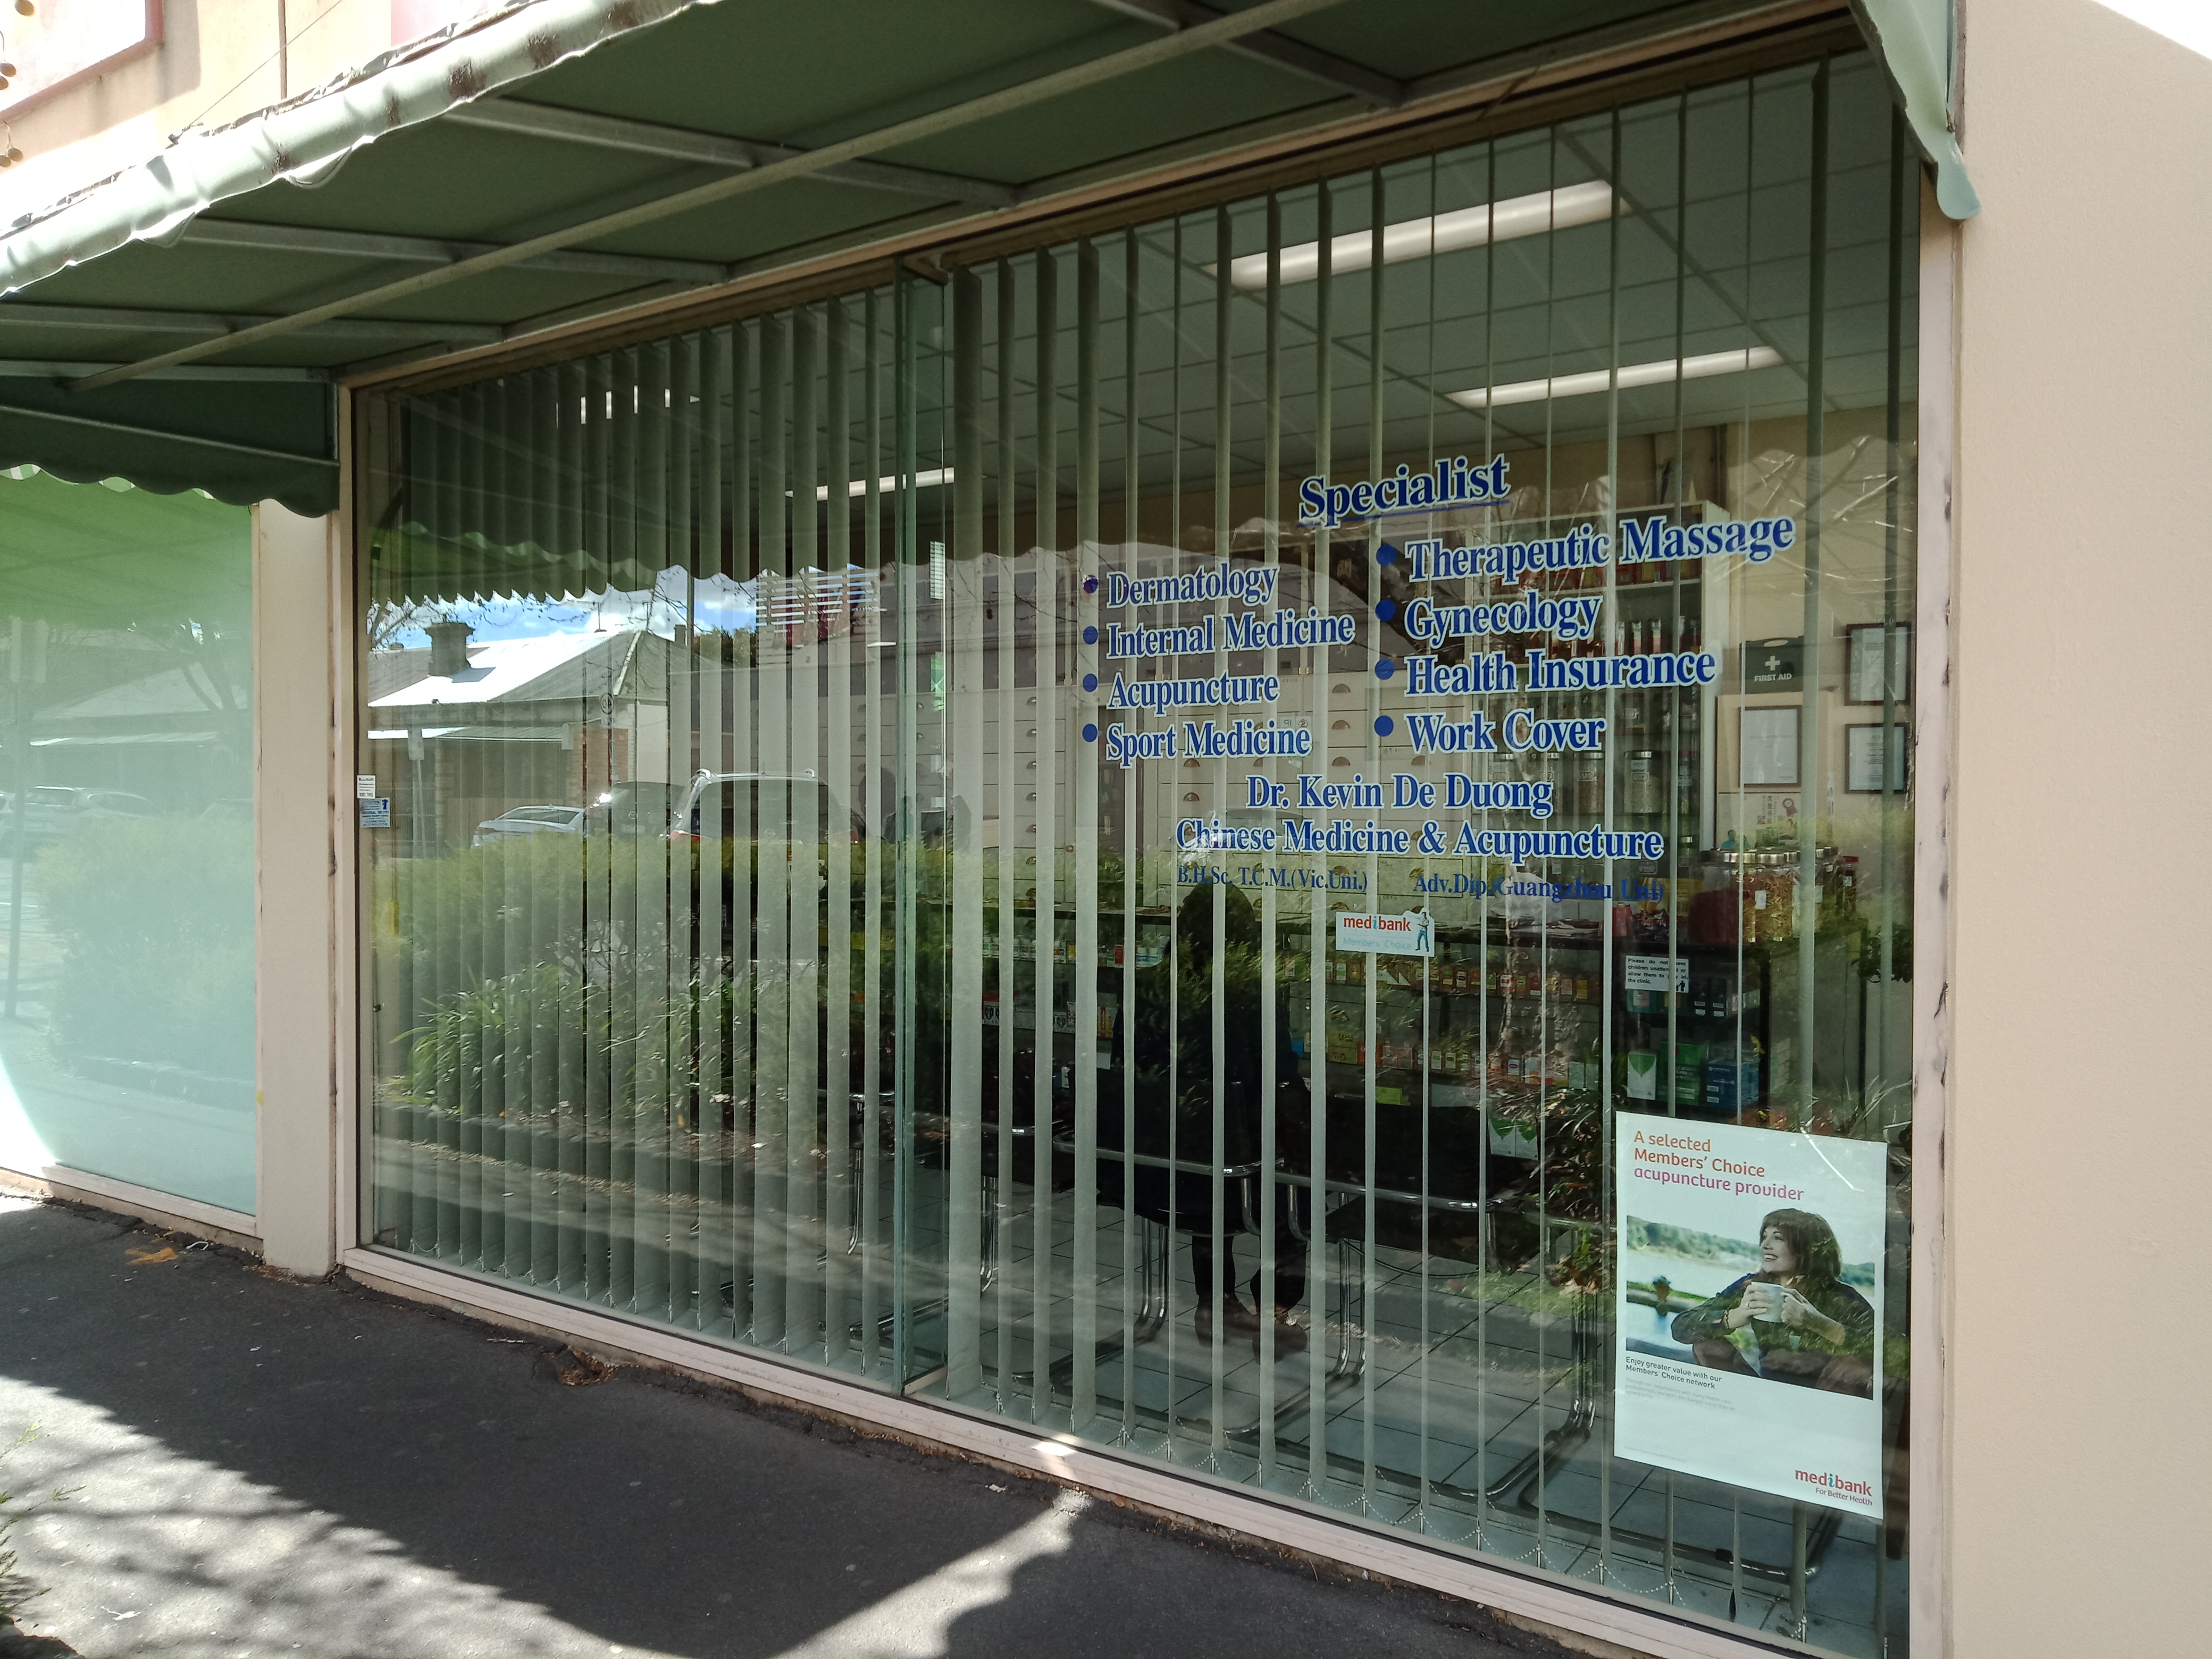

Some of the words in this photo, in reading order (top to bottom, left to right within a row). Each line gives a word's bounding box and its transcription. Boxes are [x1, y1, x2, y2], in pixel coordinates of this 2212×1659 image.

[1301, 455, 1509, 526] Specialist
[1407, 524, 1608, 583] Therapeutic
[1621, 517, 1795, 562] Massage
[1109, 565, 1278, 606] Dermatology
[1109, 616, 1213, 658] Internal
[1224, 608, 1354, 649] Medicine
[1407, 593, 1601, 646] Gynecology
[1109, 672, 1279, 714] Acupuncture
[1406, 650, 1515, 695] Health
[1528, 650, 1715, 690] Insurance
[1754, 674, 1777, 682] FIRST
[1108, 723, 1176, 766] Sport
[1185, 720, 1311, 757] Medicine
[1406, 713, 1497, 752] Work
[1505, 710, 1605, 751] Cover
[1248, 775, 1289, 808] Dr.
[1298, 774, 1382, 808] Kevin
[1393, 775, 1435, 808] De
[1444, 774, 1553, 817] Duong
[1177, 819, 1276, 851] Chinese
[1284, 819, 1409, 853] Medicine
[1418, 820, 1446, 854] &
[1454, 822, 1664, 864] Acupuncture
[1343, 936, 1381, 947] Members'
[1385, 940, 1412, 950] Choice
[1344, 915, 1412, 932] medibank
[1634, 1130, 1645, 1144] A
[1649, 1134, 1711, 1153] selected
[1635, 1168, 1731, 1191] acupuncture
[1735, 1182, 1804, 1201] provider
[1712, 1158, 1765, 1177] Choice
[1626, 1356, 1645, 1367] Enjoy
[1646, 1362, 1671, 1371] greater
[1673, 1368, 1691, 1376] value
[1662, 1371, 1685, 1382] Choice
[1686, 1378, 1715, 1389] network
[1795, 1470, 1872, 1497] medibank
[1815, 1487, 1827, 1496] For
[1828, 1490, 1849, 1501] Better
[1849, 1495, 1872, 1506] Health
